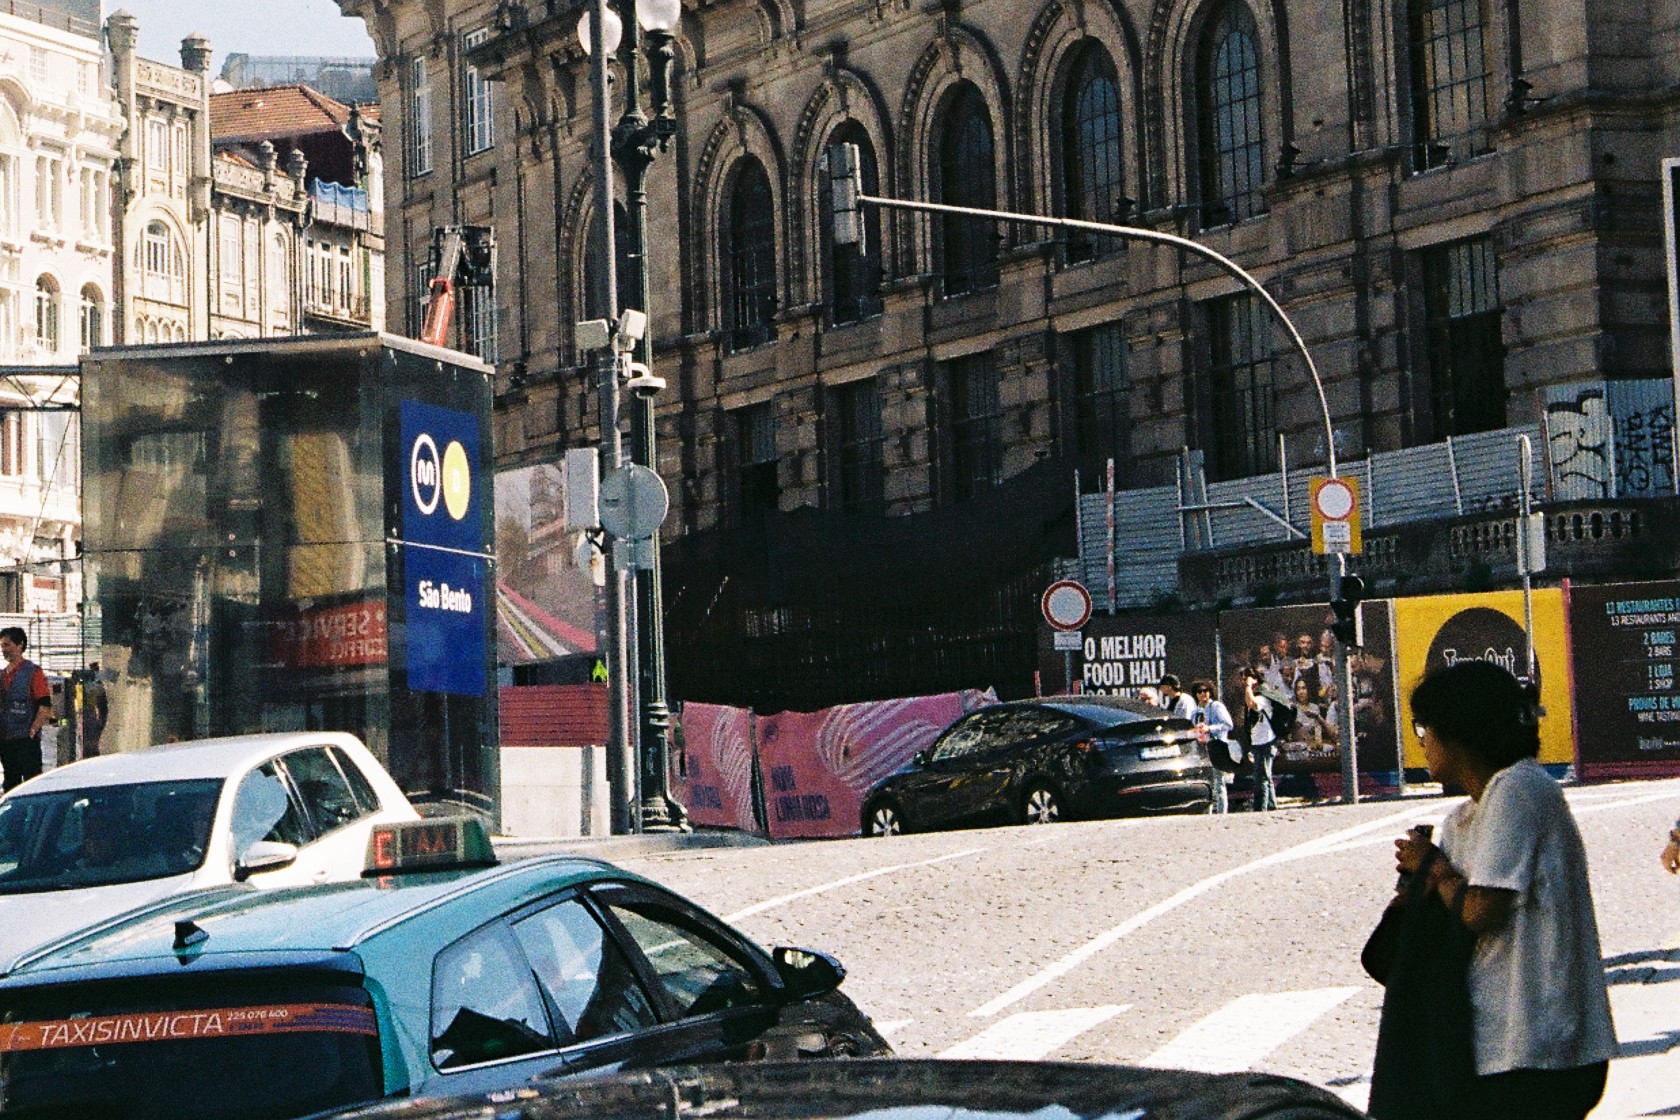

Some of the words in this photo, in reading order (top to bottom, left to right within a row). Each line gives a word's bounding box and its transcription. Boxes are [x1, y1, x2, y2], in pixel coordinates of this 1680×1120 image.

[419, 580, 439, 609] São
[440, 582, 472, 614] Bento
[1084, 637, 1096, 661] O
[1101, 634, 1166, 660] MELHOR
[1083, 662, 1124, 687] FOOD
[38, 1013, 225, 1047] TAXISINVICTA
